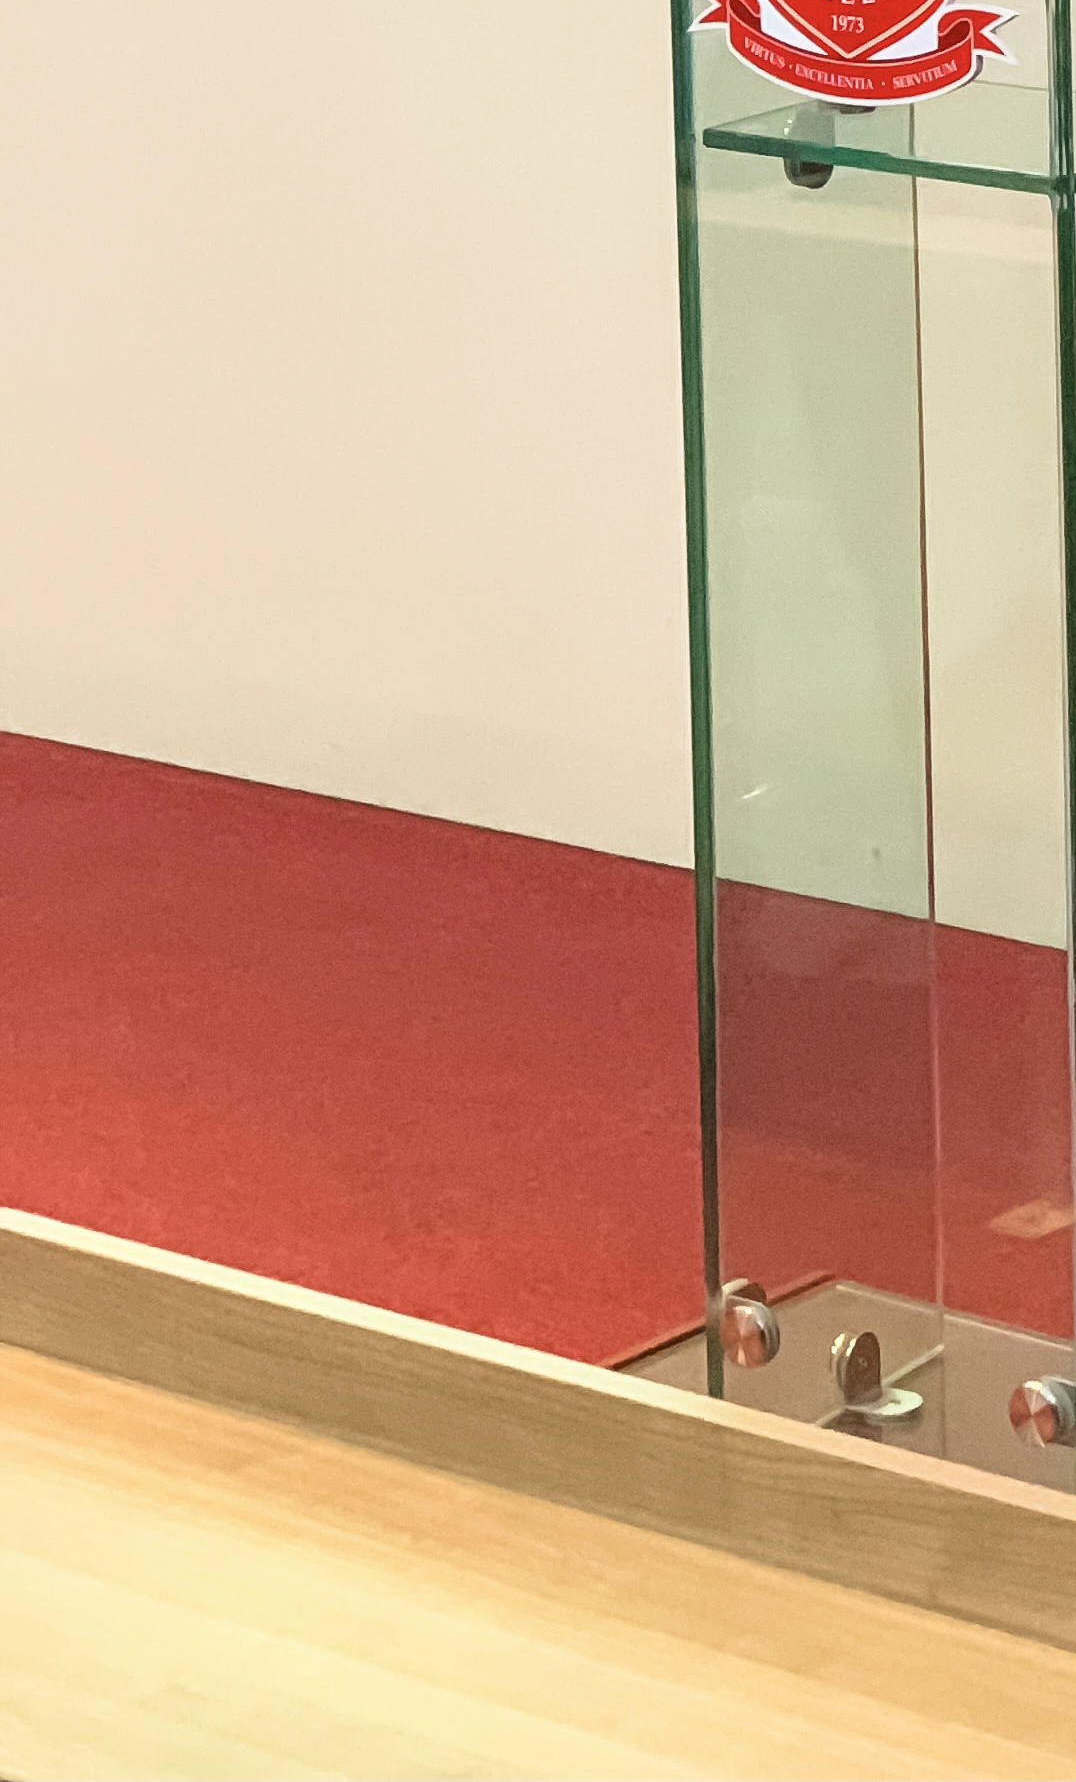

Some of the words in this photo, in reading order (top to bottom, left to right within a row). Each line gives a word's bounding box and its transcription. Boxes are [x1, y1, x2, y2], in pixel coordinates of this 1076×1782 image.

[831, 14, 865, 33] 1973
[744, 37, 785, 69] VIRTUS
[795, 63, 874, 91] EXCELLENTIA
[892, 59, 958, 90] SERVITIUM
